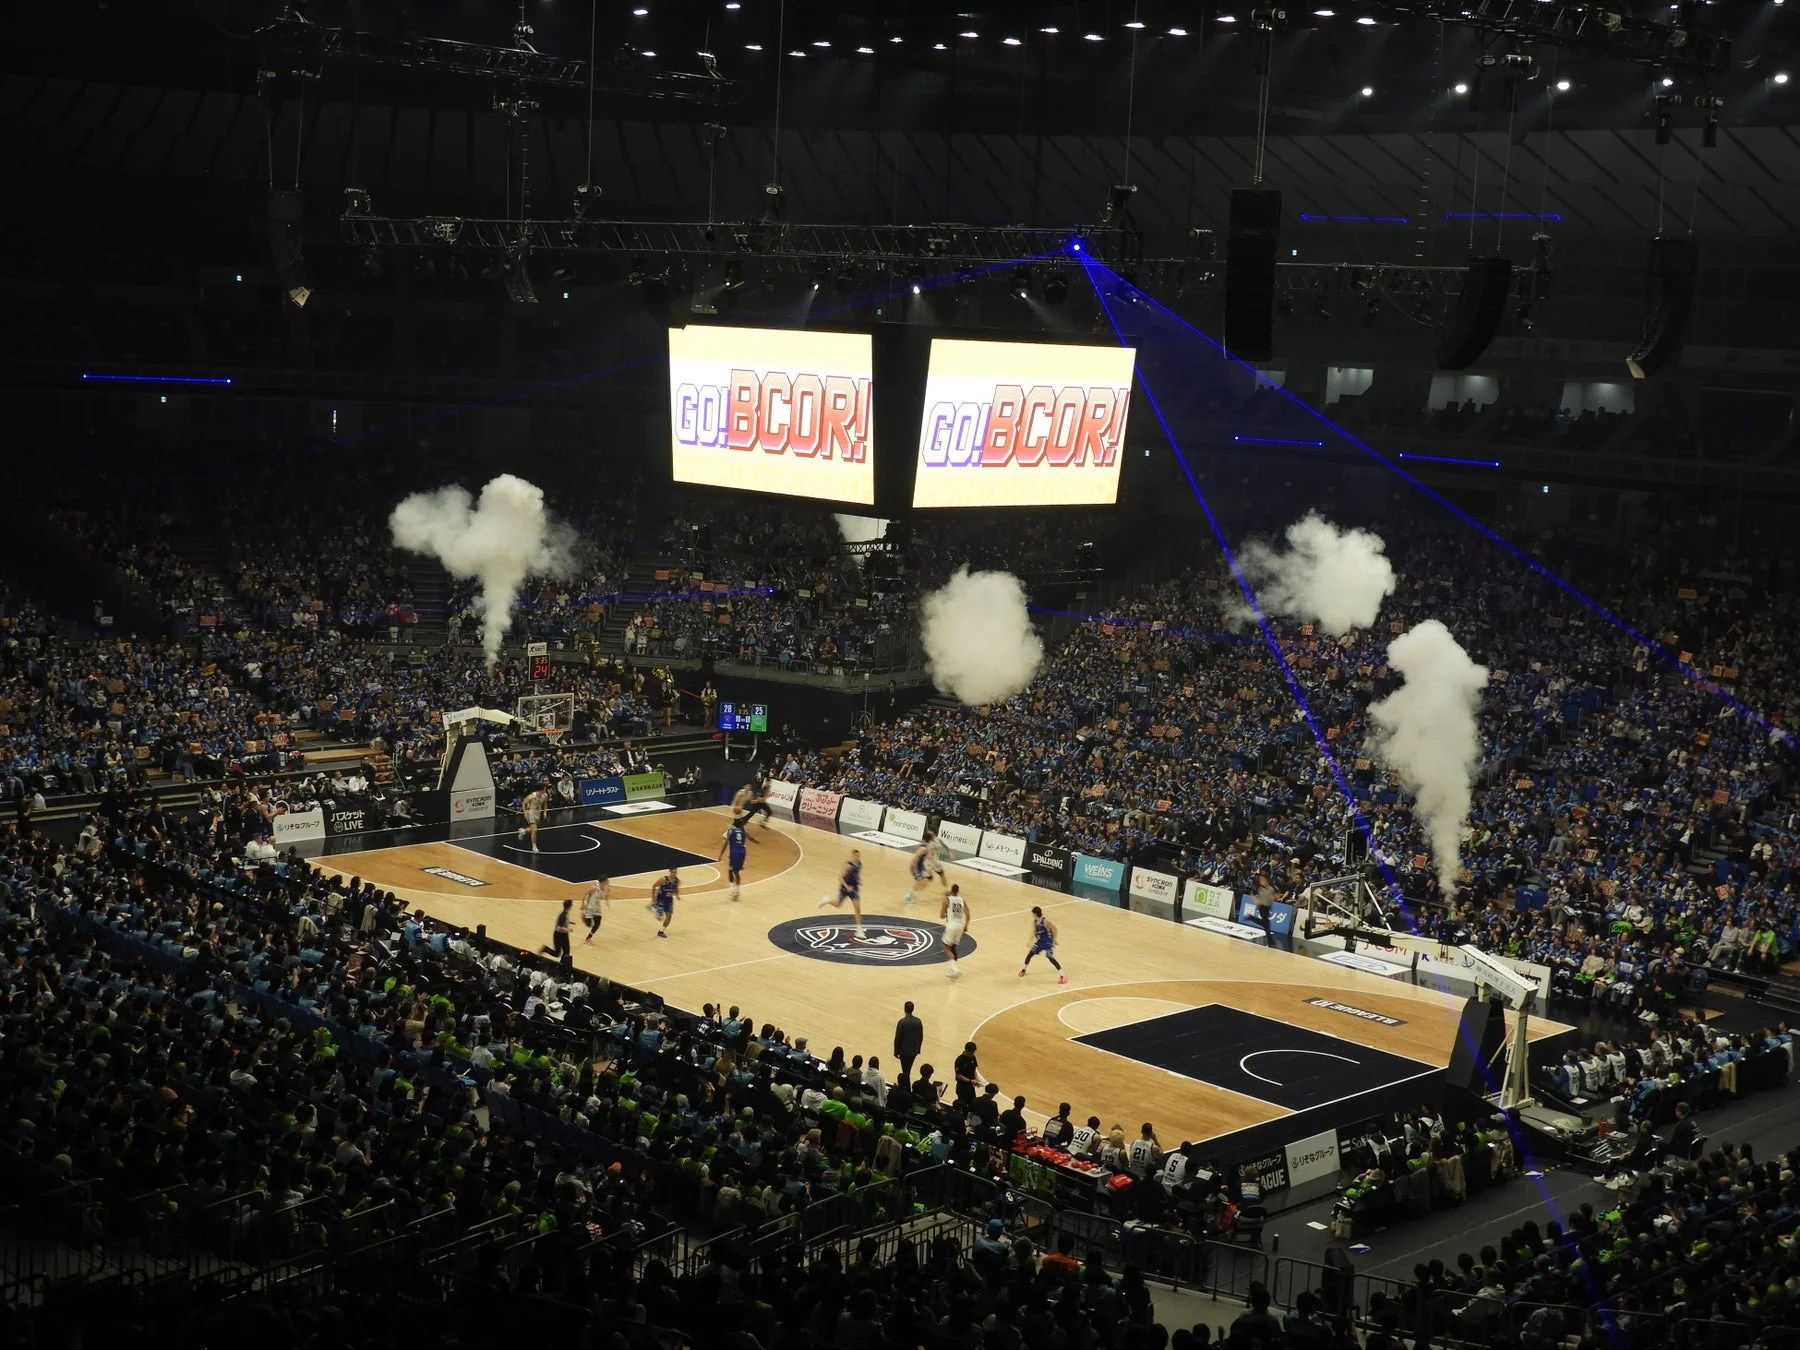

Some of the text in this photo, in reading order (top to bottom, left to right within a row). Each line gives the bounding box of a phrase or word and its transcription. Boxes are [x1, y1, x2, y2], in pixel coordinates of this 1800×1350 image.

[674, 369, 873, 464] GO! BCOR!
[922, 384, 1131, 468] GO! BCOR!
[533, 665, 548, 678] 24
[723, 704, 732, 713] 28
[755, 706, 763, 715] 25
[585, 786, 620, 796] リゾートトラスト
[330, 809, 366, 822] バスケット
[801, 802, 835, 816] クリーニング
[284, 820, 321, 831] りそなグループ
[344, 820, 364, 831] LIVE
[1031, 853, 1065, 871] SPALDING
[1145, 876, 1174, 888] SYNCRON
[1074, 1130, 1090, 1142] 30
[1133, 1147, 1146, 1161] 21
[1298, 1146, 1335, 1167] りそなグループ
[1169, 1160, 1178, 1173] 5
